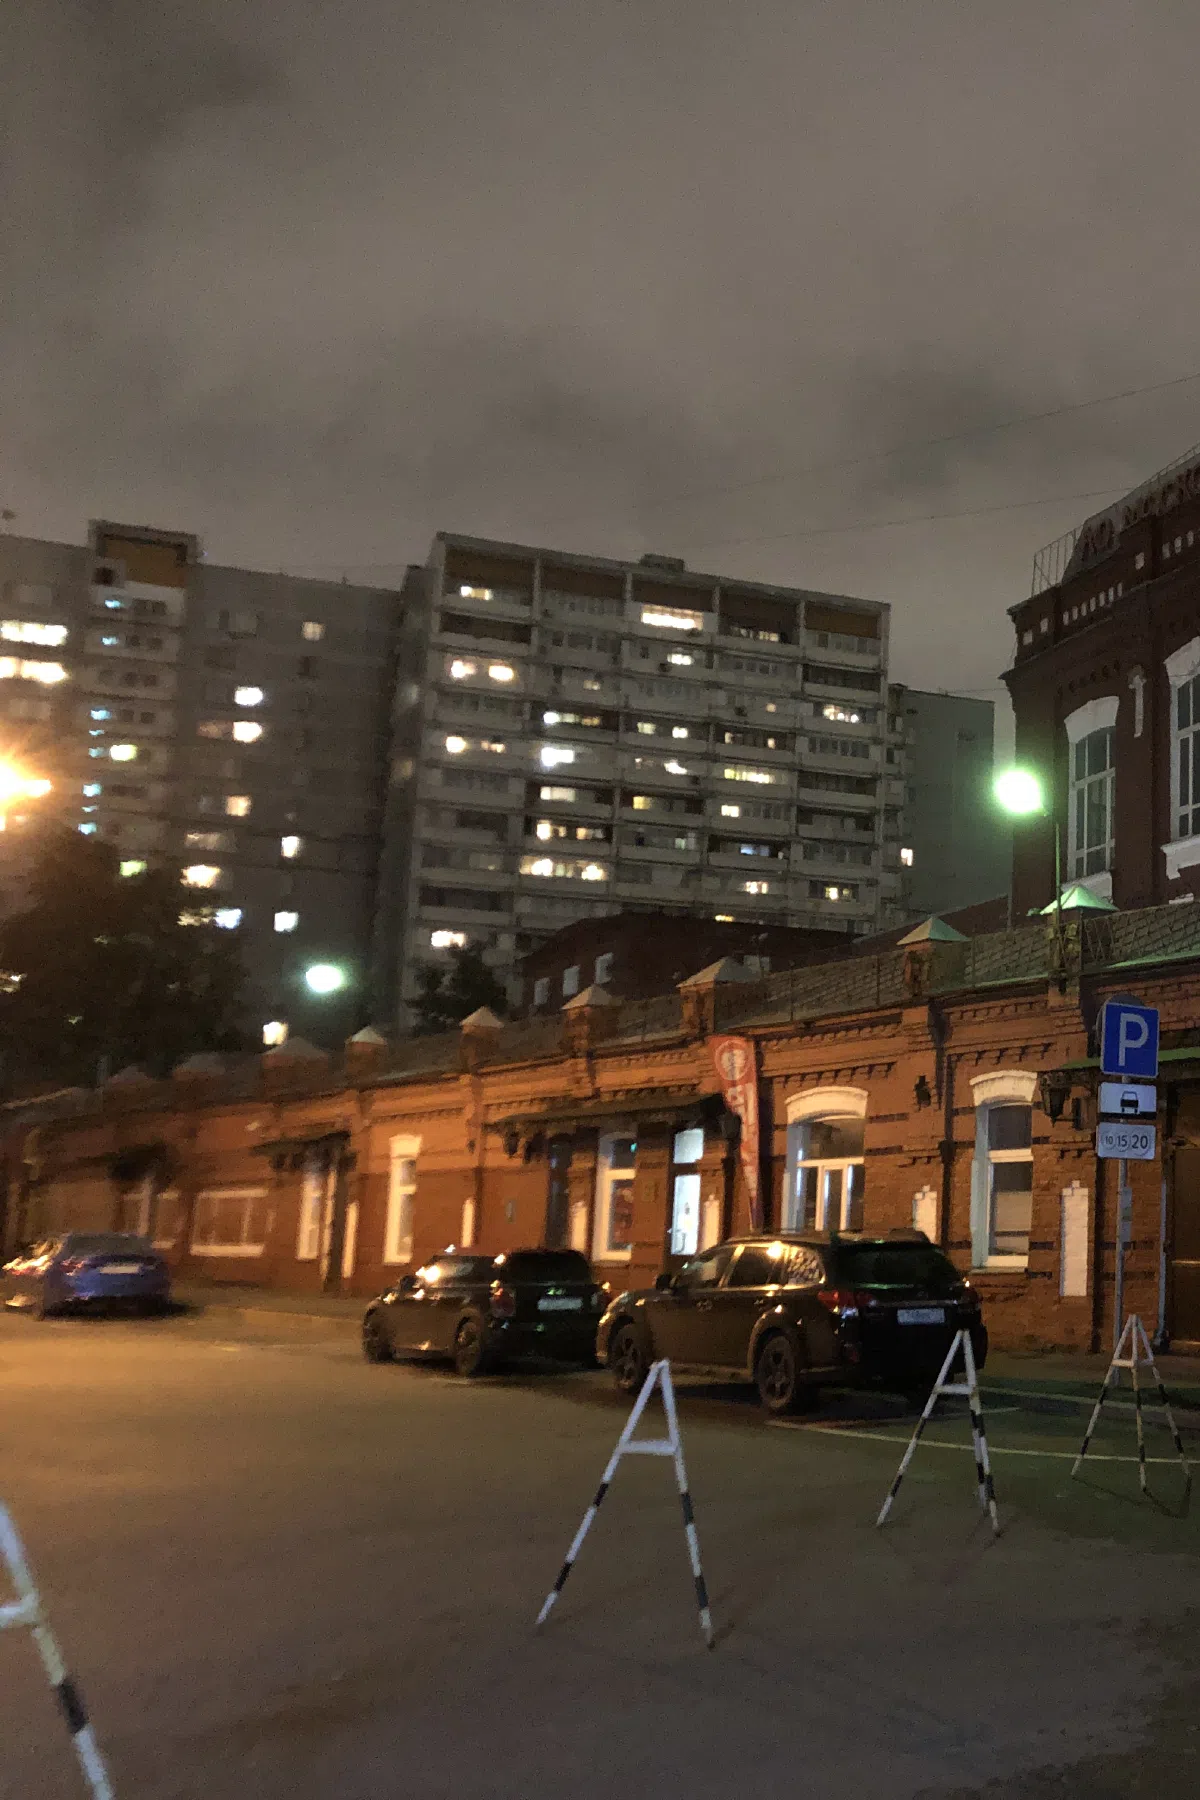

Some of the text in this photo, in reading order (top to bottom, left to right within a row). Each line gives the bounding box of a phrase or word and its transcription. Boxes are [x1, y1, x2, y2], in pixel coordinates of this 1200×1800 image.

[1118, 1012, 1149, 1067] P
[1117, 1134, 1128, 1148] 15
[1132, 1134, 1149, 1150] 20
